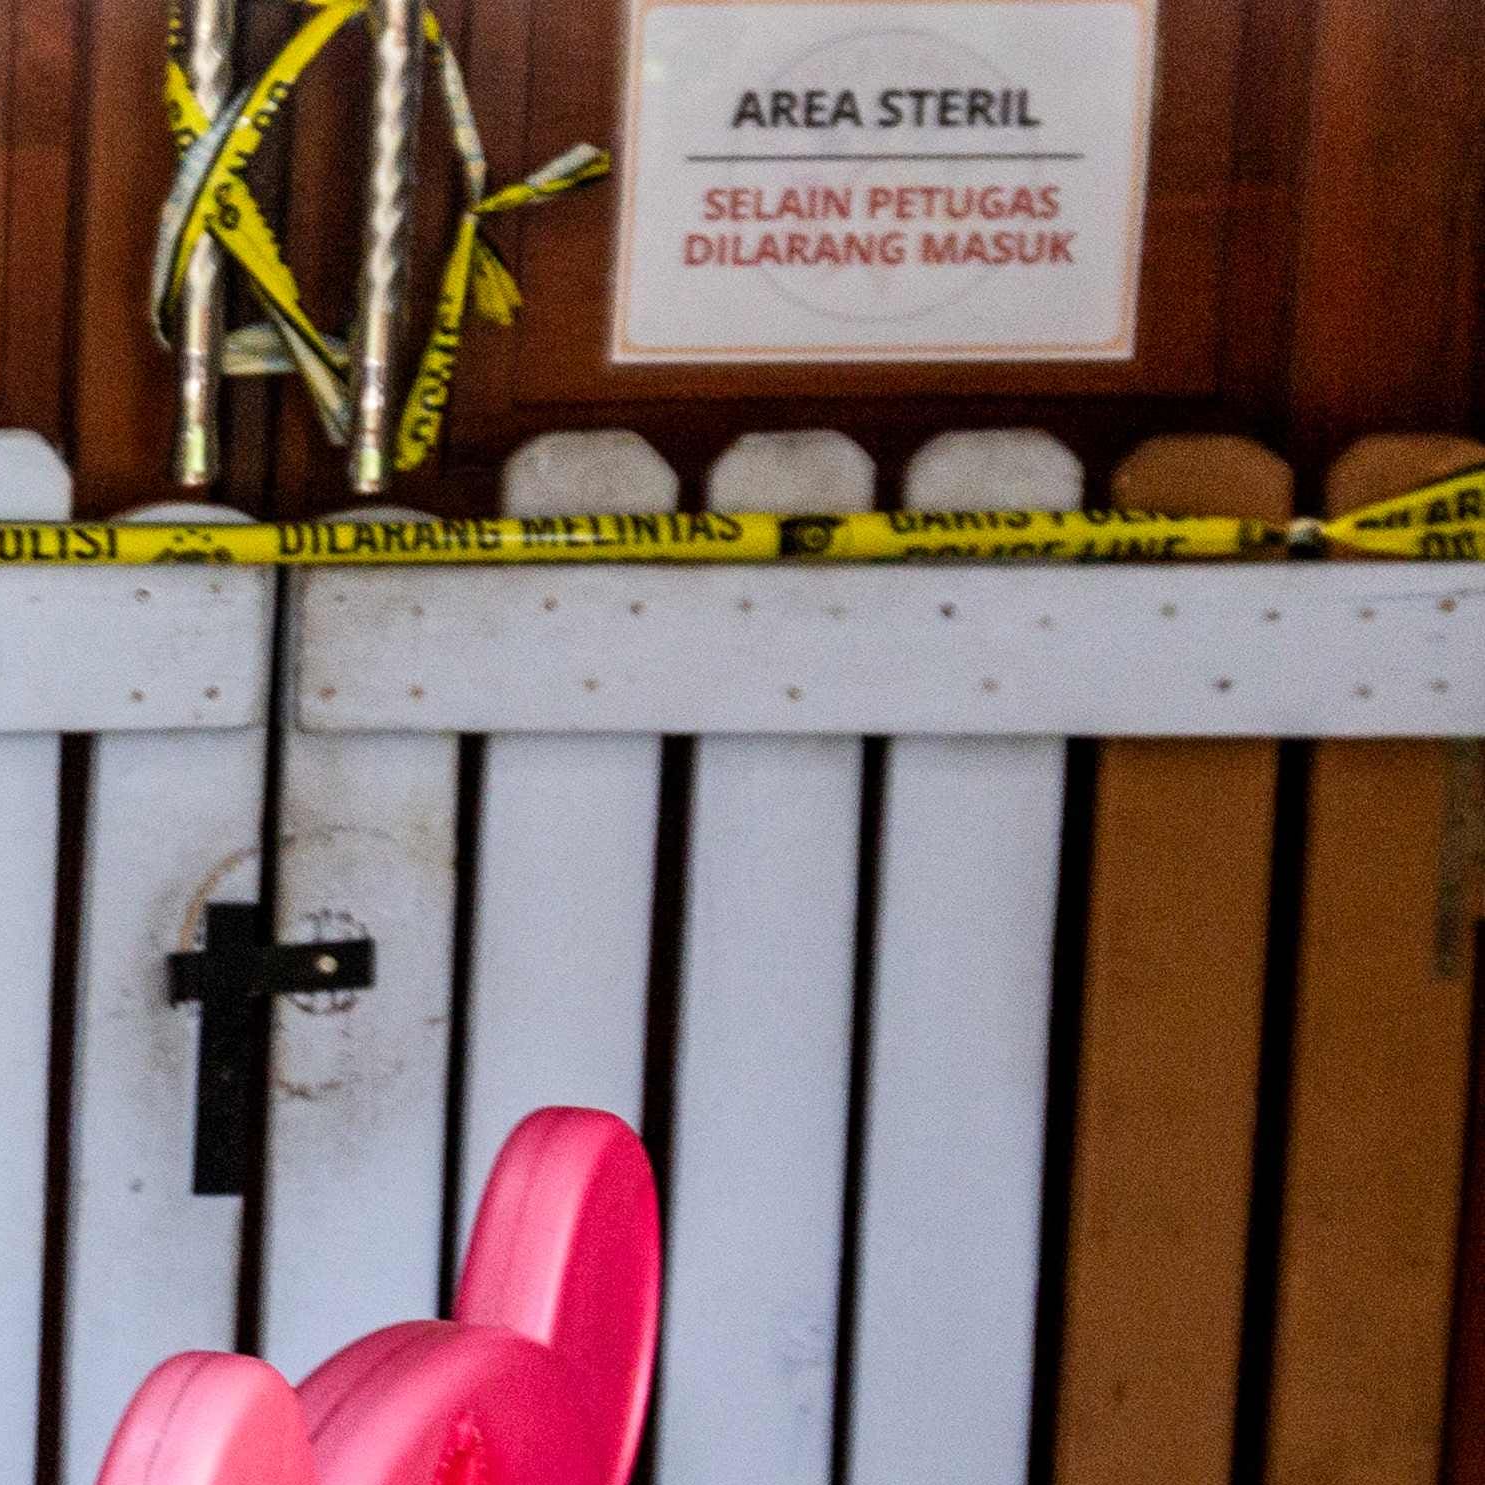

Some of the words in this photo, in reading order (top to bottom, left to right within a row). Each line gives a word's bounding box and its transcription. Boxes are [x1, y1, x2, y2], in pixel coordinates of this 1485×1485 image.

[731, 89, 863, 130] AREA
[877, 87, 1041, 129] STERIL
[702, 187, 853, 221] SELAIN
[866, 184, 1063, 220] PETUGAS
[682, 232, 907, 267] DILARANG
[920, 231, 1078, 266] MASUK
[276, 520, 503, 556] DILARANG
[515, 511, 744, 549] MELINTAS
